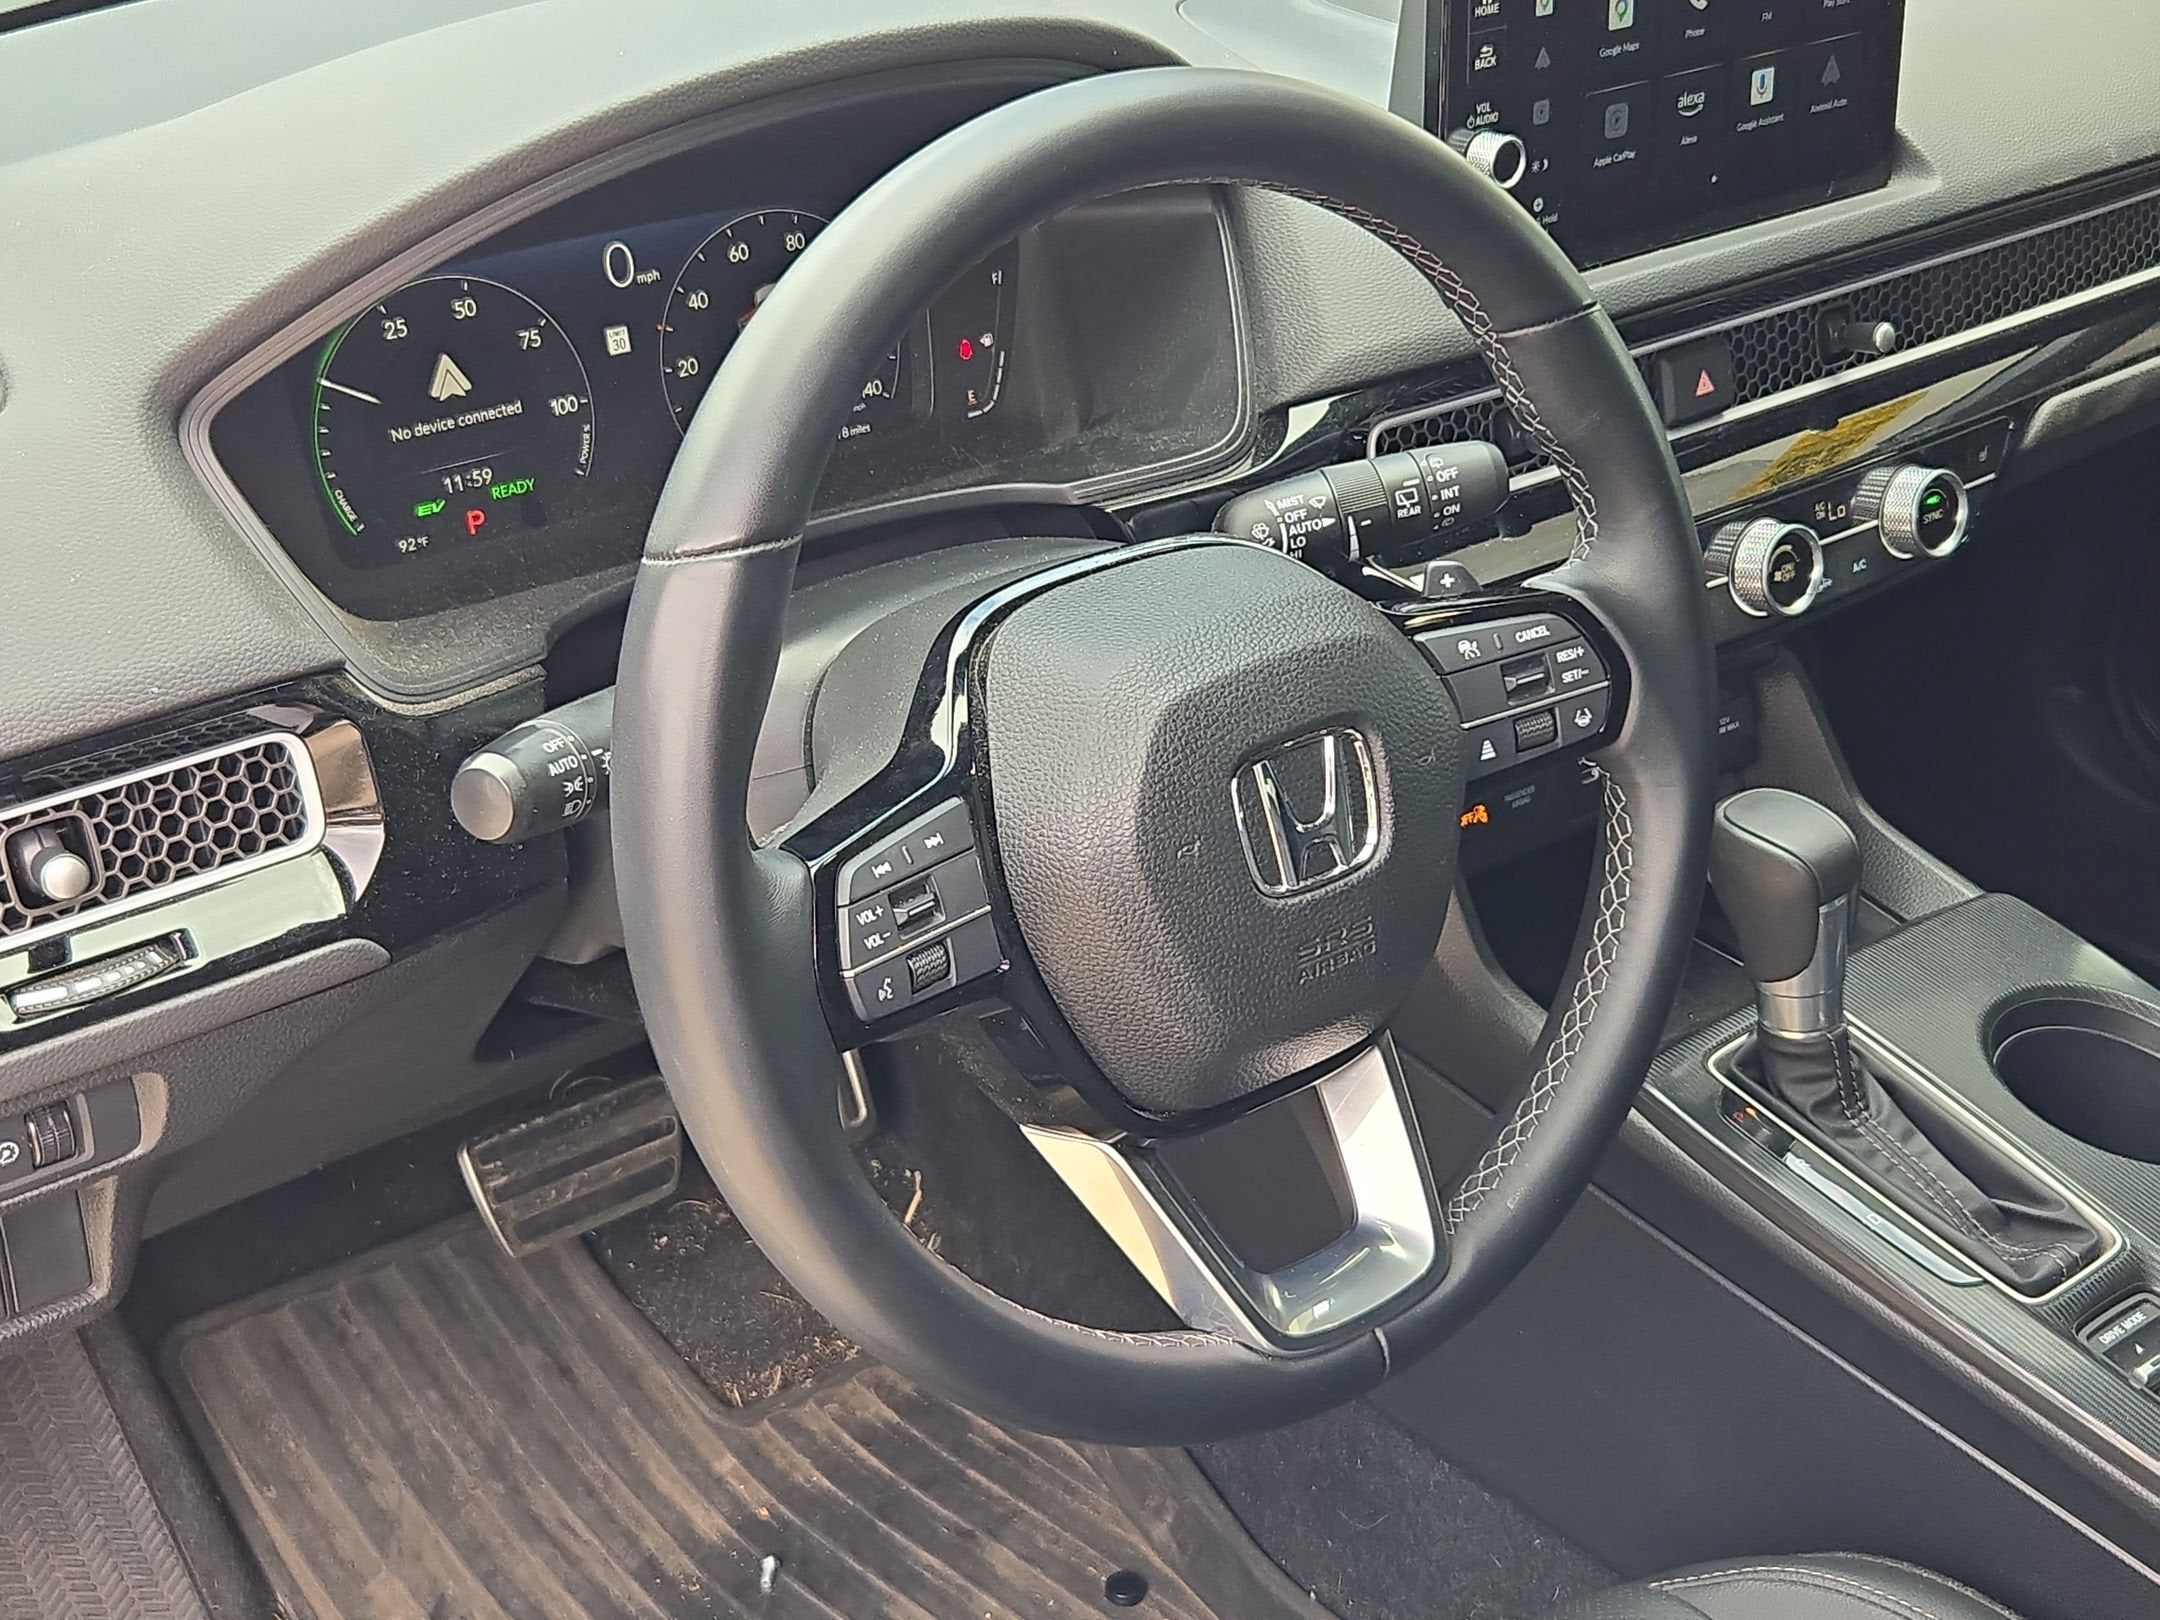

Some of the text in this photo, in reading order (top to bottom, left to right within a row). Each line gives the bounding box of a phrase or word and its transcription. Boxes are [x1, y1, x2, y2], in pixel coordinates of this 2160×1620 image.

[1474, 3, 1499, 17] HOME
[1685, 28, 1705, 39] Phone
[1599, 41, 1640, 58] Google Maps
[1474, 56, 1497, 71] BACK
[1476, 102, 1491, 114] VOL
[1677, 91, 1705, 109] alexa
[1475, 111, 1499, 126] AUDIO
[1736, 113, 1784, 133] Google Assistant
[1593, 150, 1637, 168] Apple CarPlay
[785, 233, 806, 251] 80
[729, 243, 749, 263] 60
[604, 241, 661, 288] 0 mph
[452, 299, 477, 320] 50
[688, 291, 708, 310] 40
[384, 318, 408, 340] 25
[519, 329, 541, 350] 75
[612, 337, 626, 351] 30
[677, 357, 698, 378] 20
[550, 395, 578, 417] 100
[389, 400, 523, 443] No device connected
[850, 424, 871, 437] miles
[580, 433, 590, 464] POWER
[442, 467, 493, 495] 11:59
[1435, 467, 1459, 482] OFF
[491, 477, 536, 499] READY
[1440, 486, 1461, 500] INT
[334, 488, 359, 523] CHARGE
[415, 499, 446, 518] EV
[1276, 494, 1304, 510] MIST
[1443, 503, 1461, 516] ON
[1284, 508, 1308, 523] OFF
[1397, 505, 1422, 519] REAR
[1923, 508, 1944, 525] SYNC
[464, 509, 485, 535] P
[1289, 518, 1324, 537] AUTO
[1290, 536, 1307, 549] LO
[1514, 625, 1550, 644] CANCEL
[1556, 646, 1585, 663] RES/+
[1562, 668, 1589, 684] SET/-
[542, 737, 566, 753] OFF
[548, 755, 579, 777] AUTO
[1299, 916, 1373, 957] SRS
[1300, 940, 1376, 983] AIRBAG
[2098, 1311, 2147, 1344] DRIVE MODE
